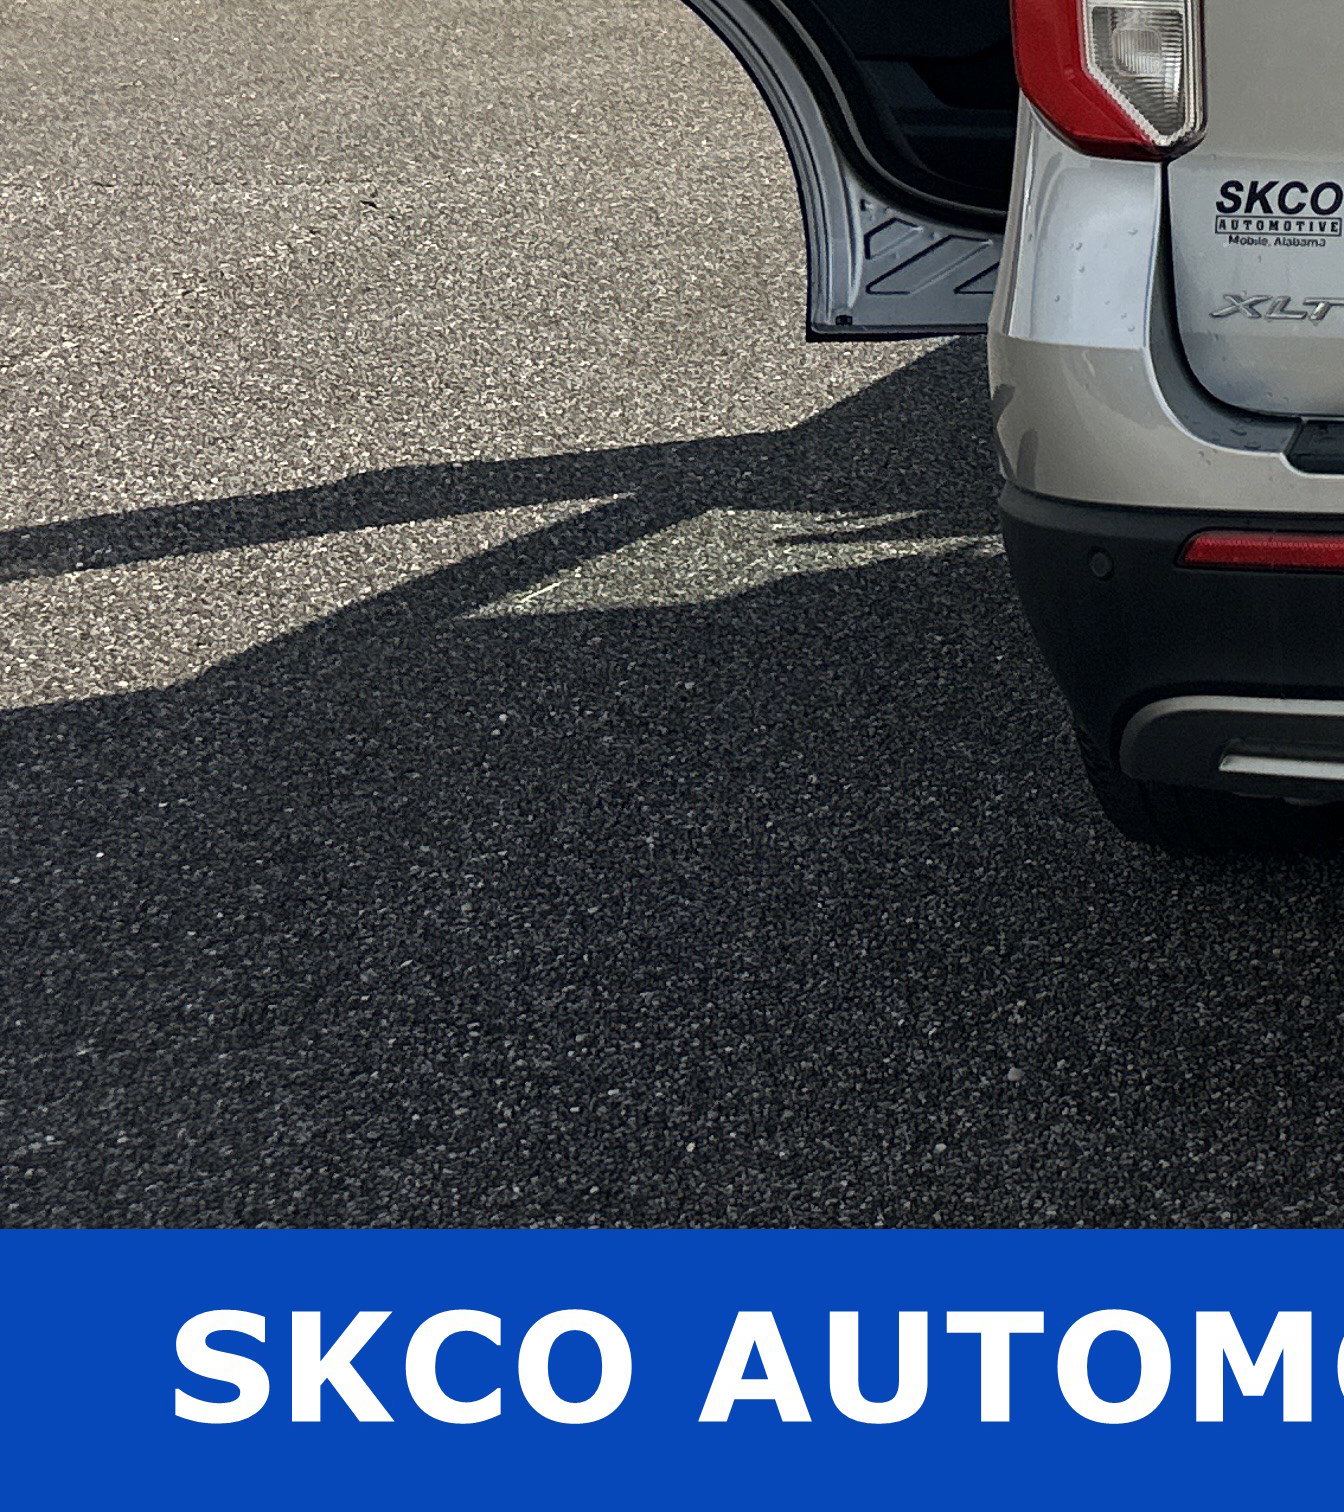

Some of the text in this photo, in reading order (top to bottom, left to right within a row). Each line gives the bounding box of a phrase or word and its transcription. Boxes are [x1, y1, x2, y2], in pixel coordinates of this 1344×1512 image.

[1215, 179, 1344, 216] SKCO
[1218, 219, 1339, 233] AUTOMOTIVE
[1273, 235, 1327, 248] Alabama
